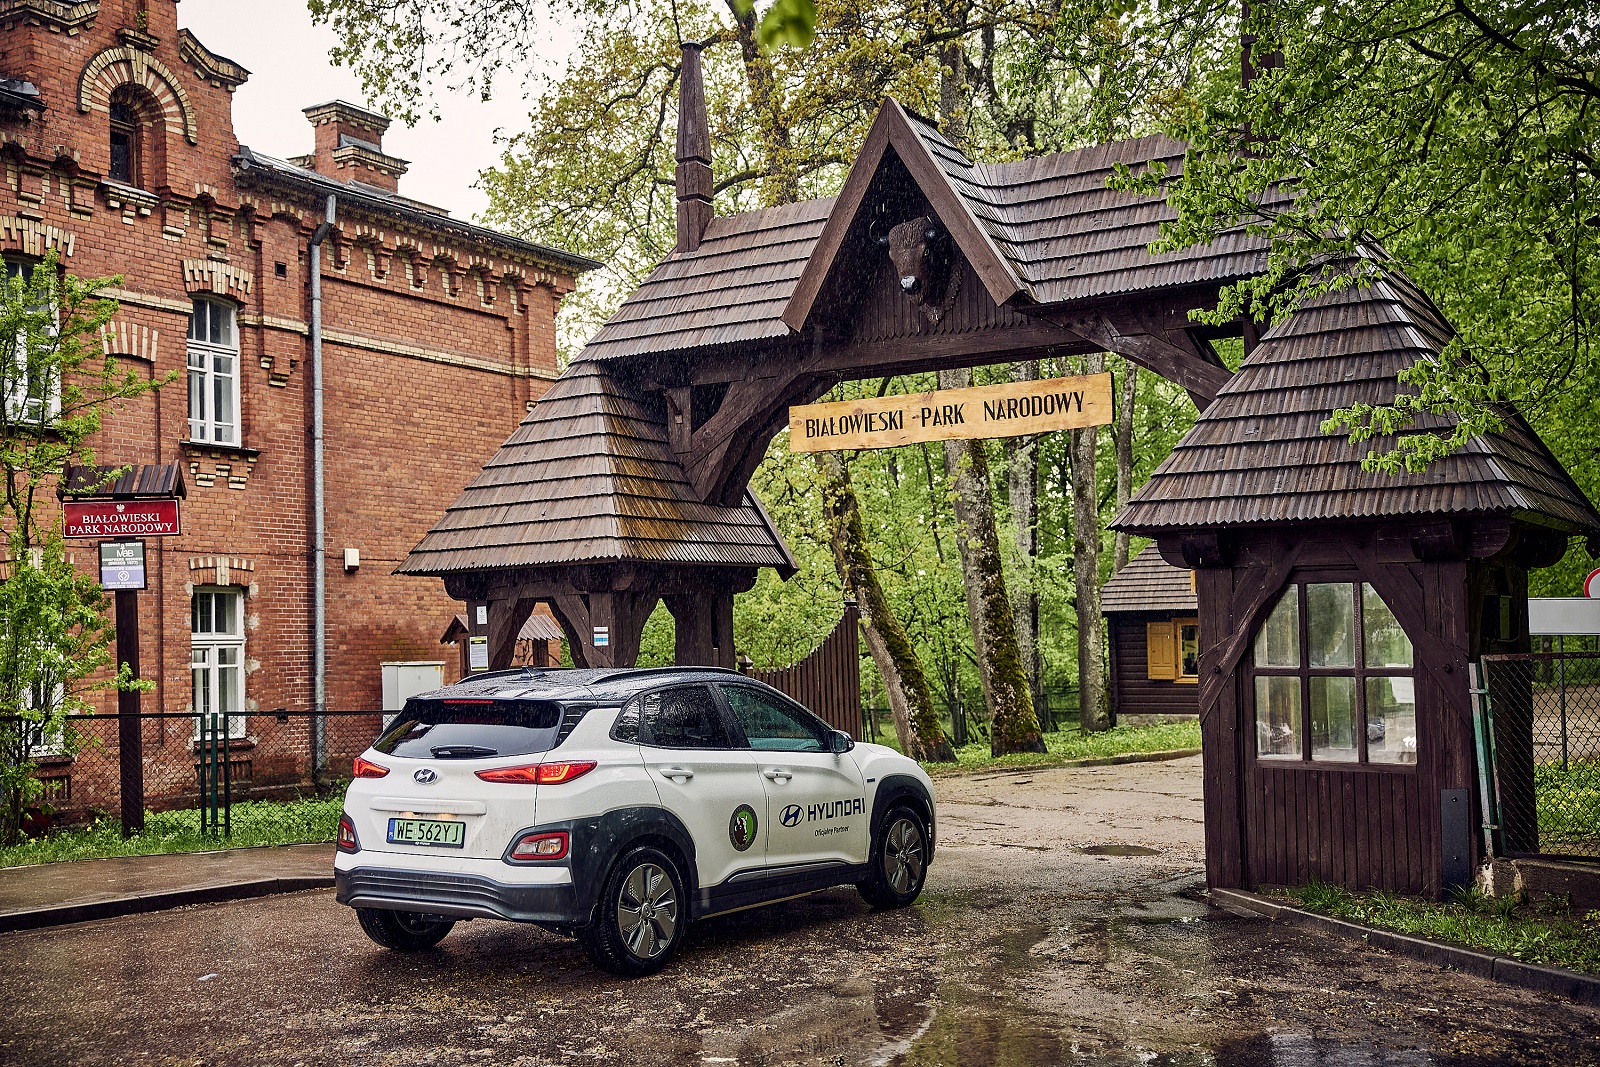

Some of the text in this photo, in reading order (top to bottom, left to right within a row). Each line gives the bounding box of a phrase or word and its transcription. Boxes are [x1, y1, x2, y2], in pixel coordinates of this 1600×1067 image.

[806, 391, 1085, 438] BIAŁOWIESKI PARK NARODOWY
[70, 523, 172, 534] PARK NARODOWY
[82, 513, 160, 524] BIAŁOWIESKI
[807, 797, 866, 822] HYUNDAI
[398, 822, 458, 842] WE 562YJ
